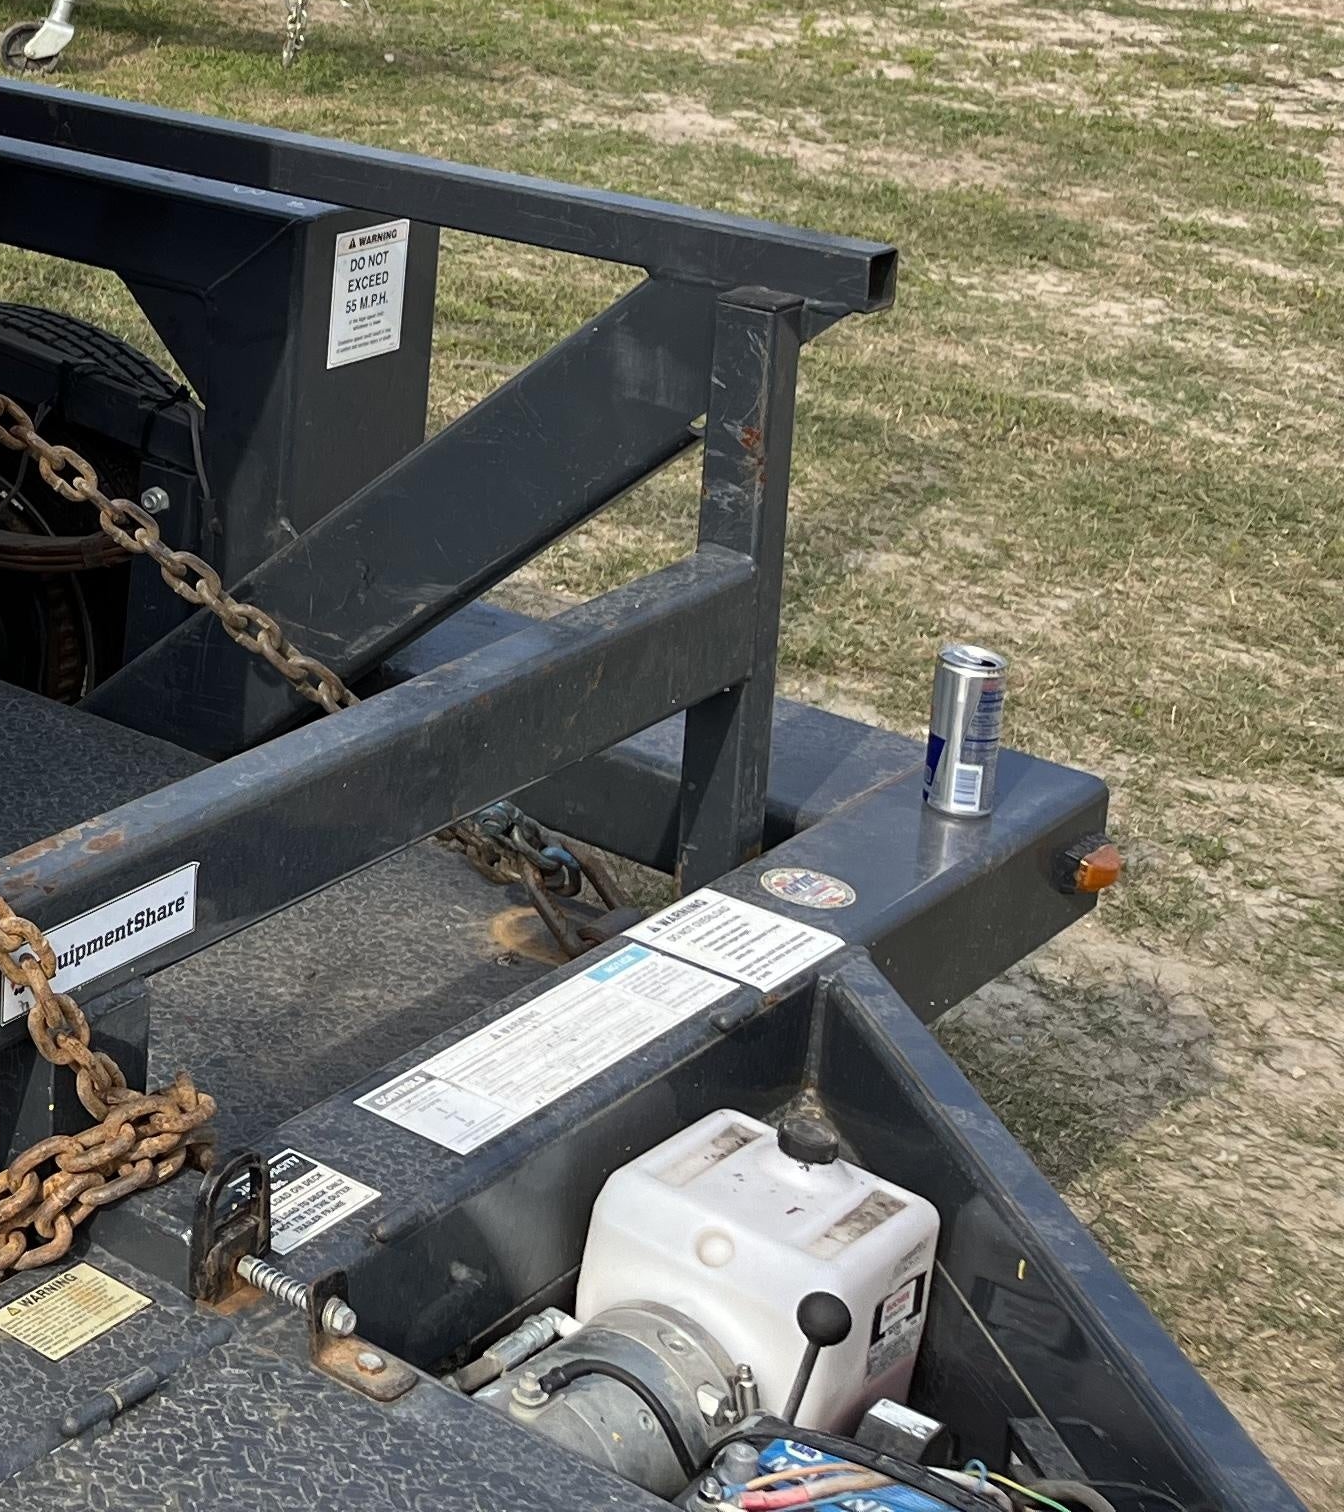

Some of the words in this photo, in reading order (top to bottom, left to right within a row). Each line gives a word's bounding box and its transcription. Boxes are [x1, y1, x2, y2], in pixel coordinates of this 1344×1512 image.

[358, 228, 398, 247] WARNING
[350, 256, 366, 272] DO
[367, 250, 390, 268] NOT
[347, 270, 389, 293] EXCEED
[345, 299, 357, 314] 55
[359, 291, 389, 310] M.P.H.
[660, 898, 710, 928] WARNING
[666, 932, 680, 943] DO
[680, 925, 694, 937] NOT
[691, 904, 732, 930] OVERLOAD
[56, 896, 185, 970] uipmentShare
[374, 1075, 427, 1106] CONTROLS
[271, 1189, 292, 1207] LOAD
[290, 1185, 303, 1196] ON
[303, 1171, 326, 1188] DECK
[282, 1206, 299, 1220] LOAD
[297, 1201, 310, 1212] TO
[310, 1190, 327, 1207] DECK
[326, 1177, 346, 1194] ONLY
[277, 1221, 294, 1235] NOT
[305, 1207, 316, 1218] TO
[314, 1198, 329, 1213] THE
[327, 1185, 352, 1203] OUTER
[293, 1211, 324, 1234] TRAILER
[16, 1272, 79, 1308] WARNING
